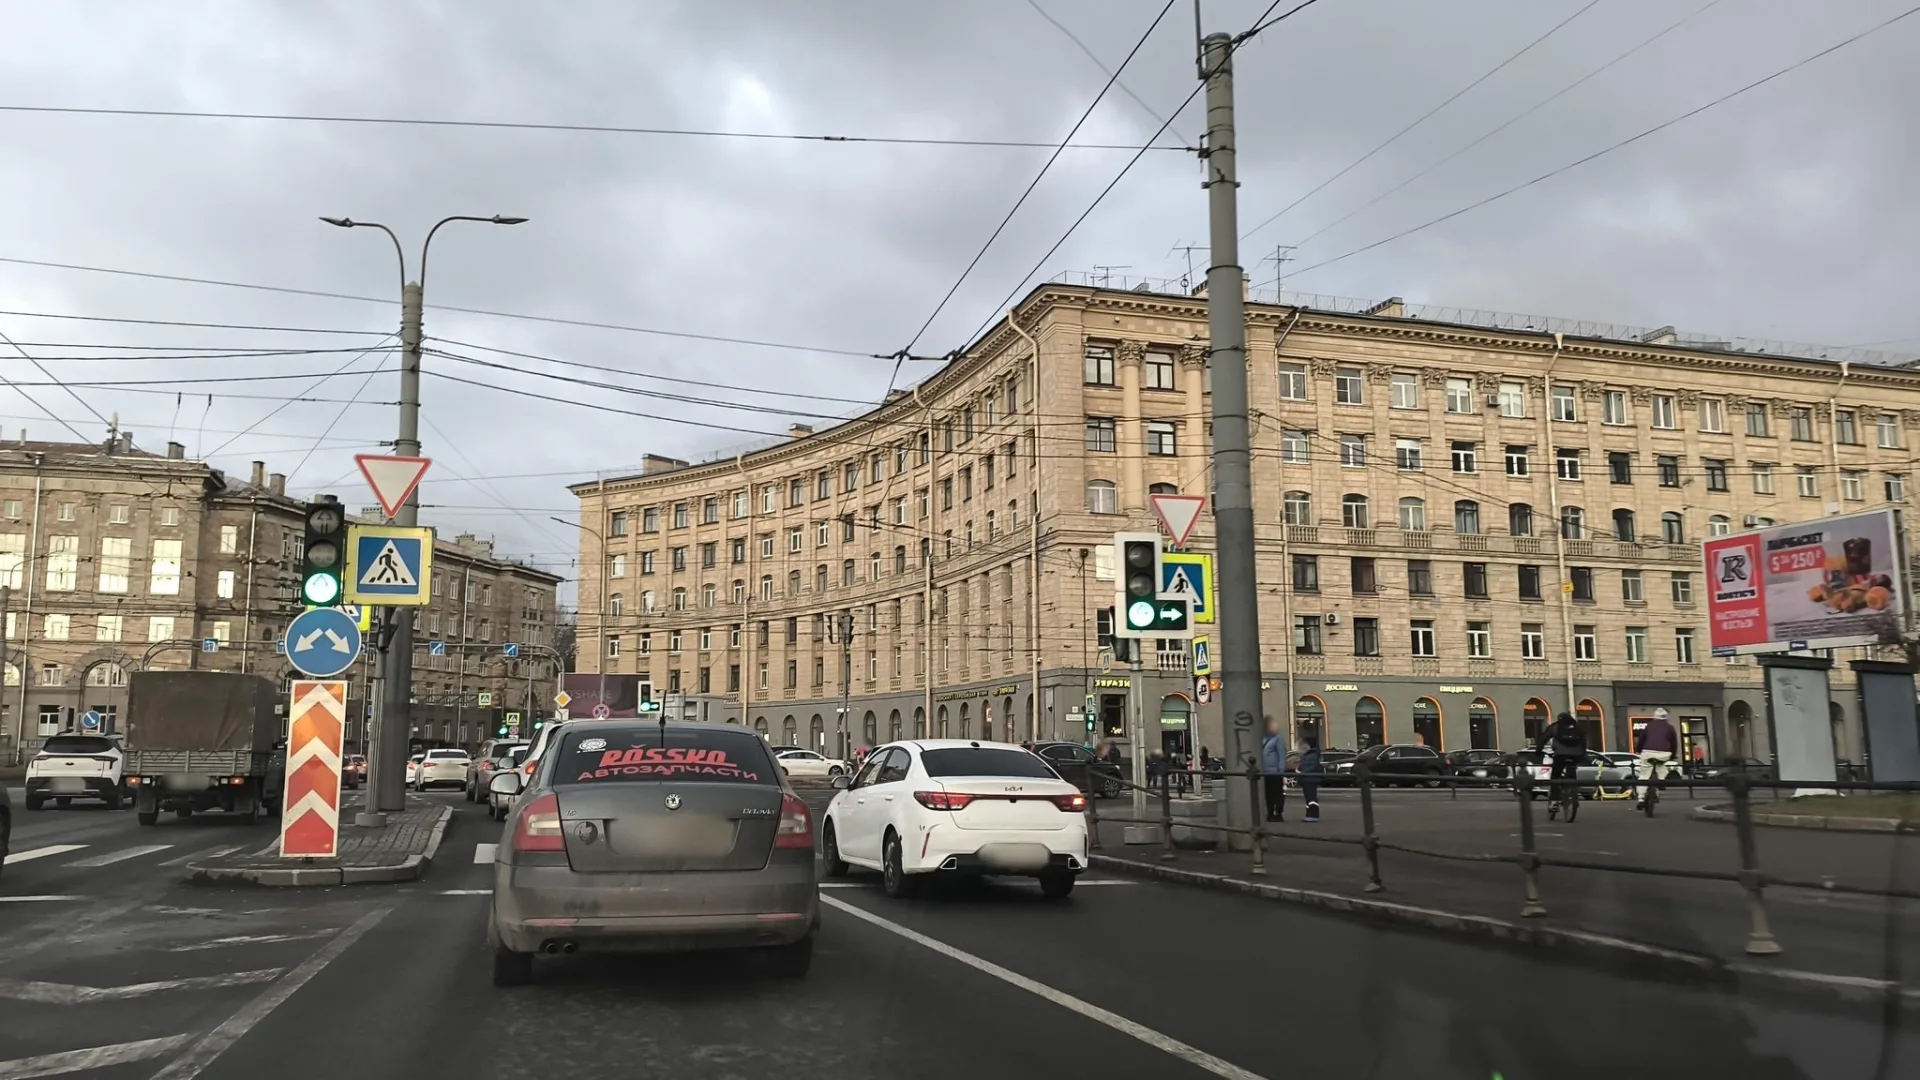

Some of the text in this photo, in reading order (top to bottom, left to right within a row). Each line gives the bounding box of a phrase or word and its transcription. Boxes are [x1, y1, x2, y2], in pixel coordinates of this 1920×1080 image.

[1772, 556, 1780, 572] 5
[566, 689, 613, 699] O'SHAE
[578, 765, 758, 781] АВТОЗАПЧАСТИ
